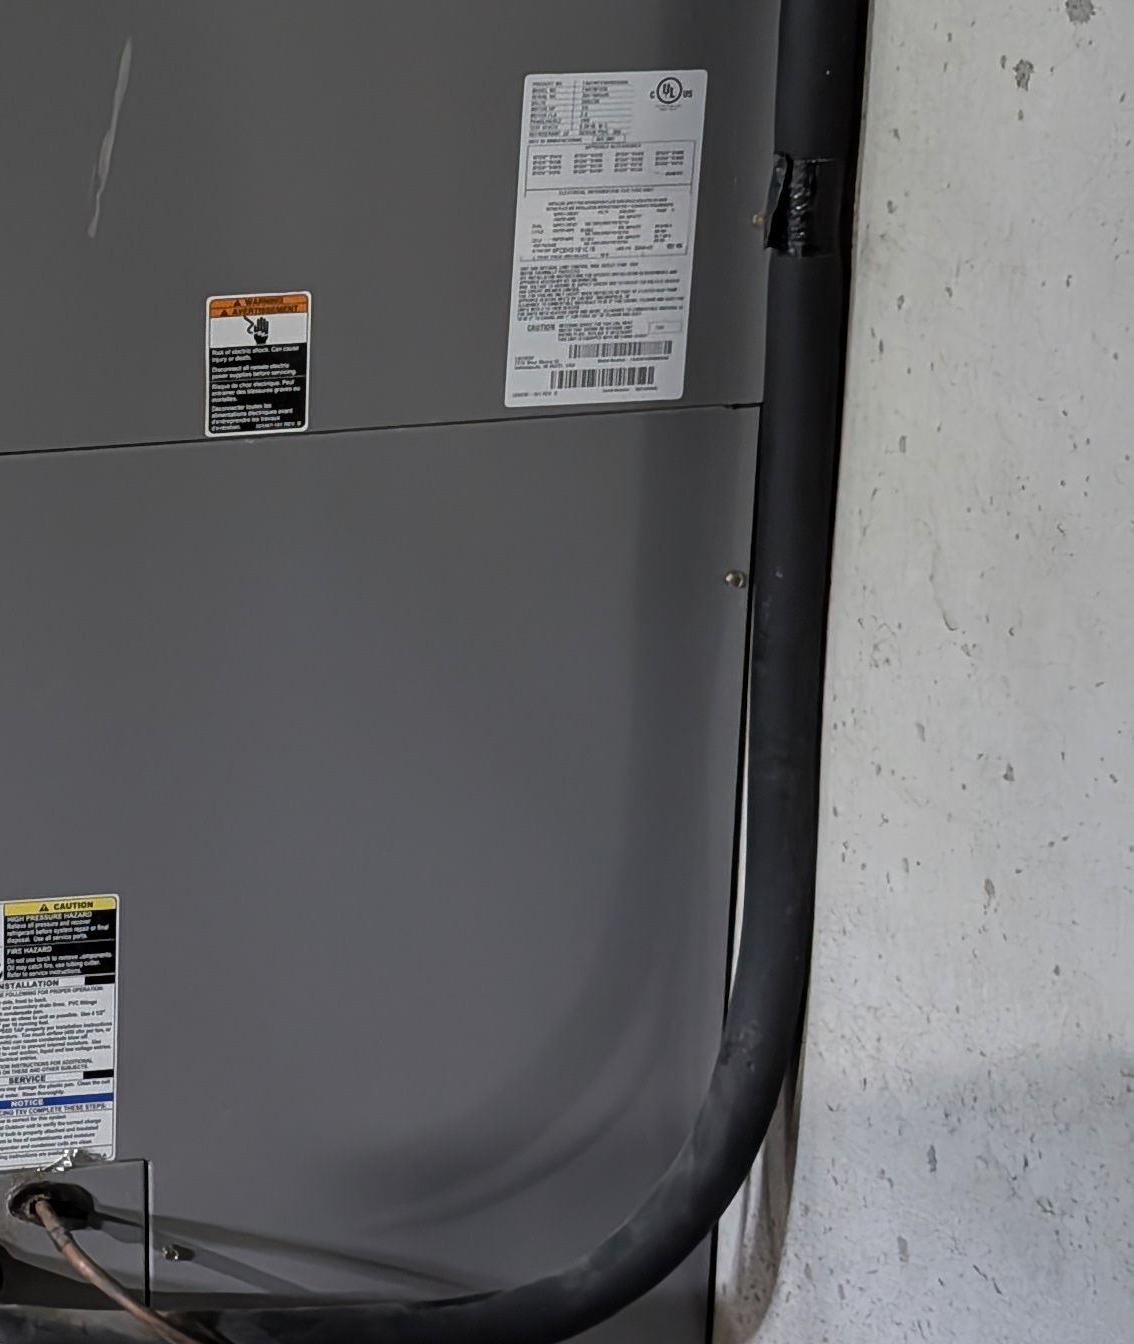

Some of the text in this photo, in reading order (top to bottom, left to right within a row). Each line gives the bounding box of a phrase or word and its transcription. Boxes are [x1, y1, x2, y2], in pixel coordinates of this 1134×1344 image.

[527, 324, 556, 332] CAUTION
[53, 901, 94, 911] CAUTION
[8, 1074, 45, 1084] SERVICE
[10, 1098, 43, 1107] NOTICE
